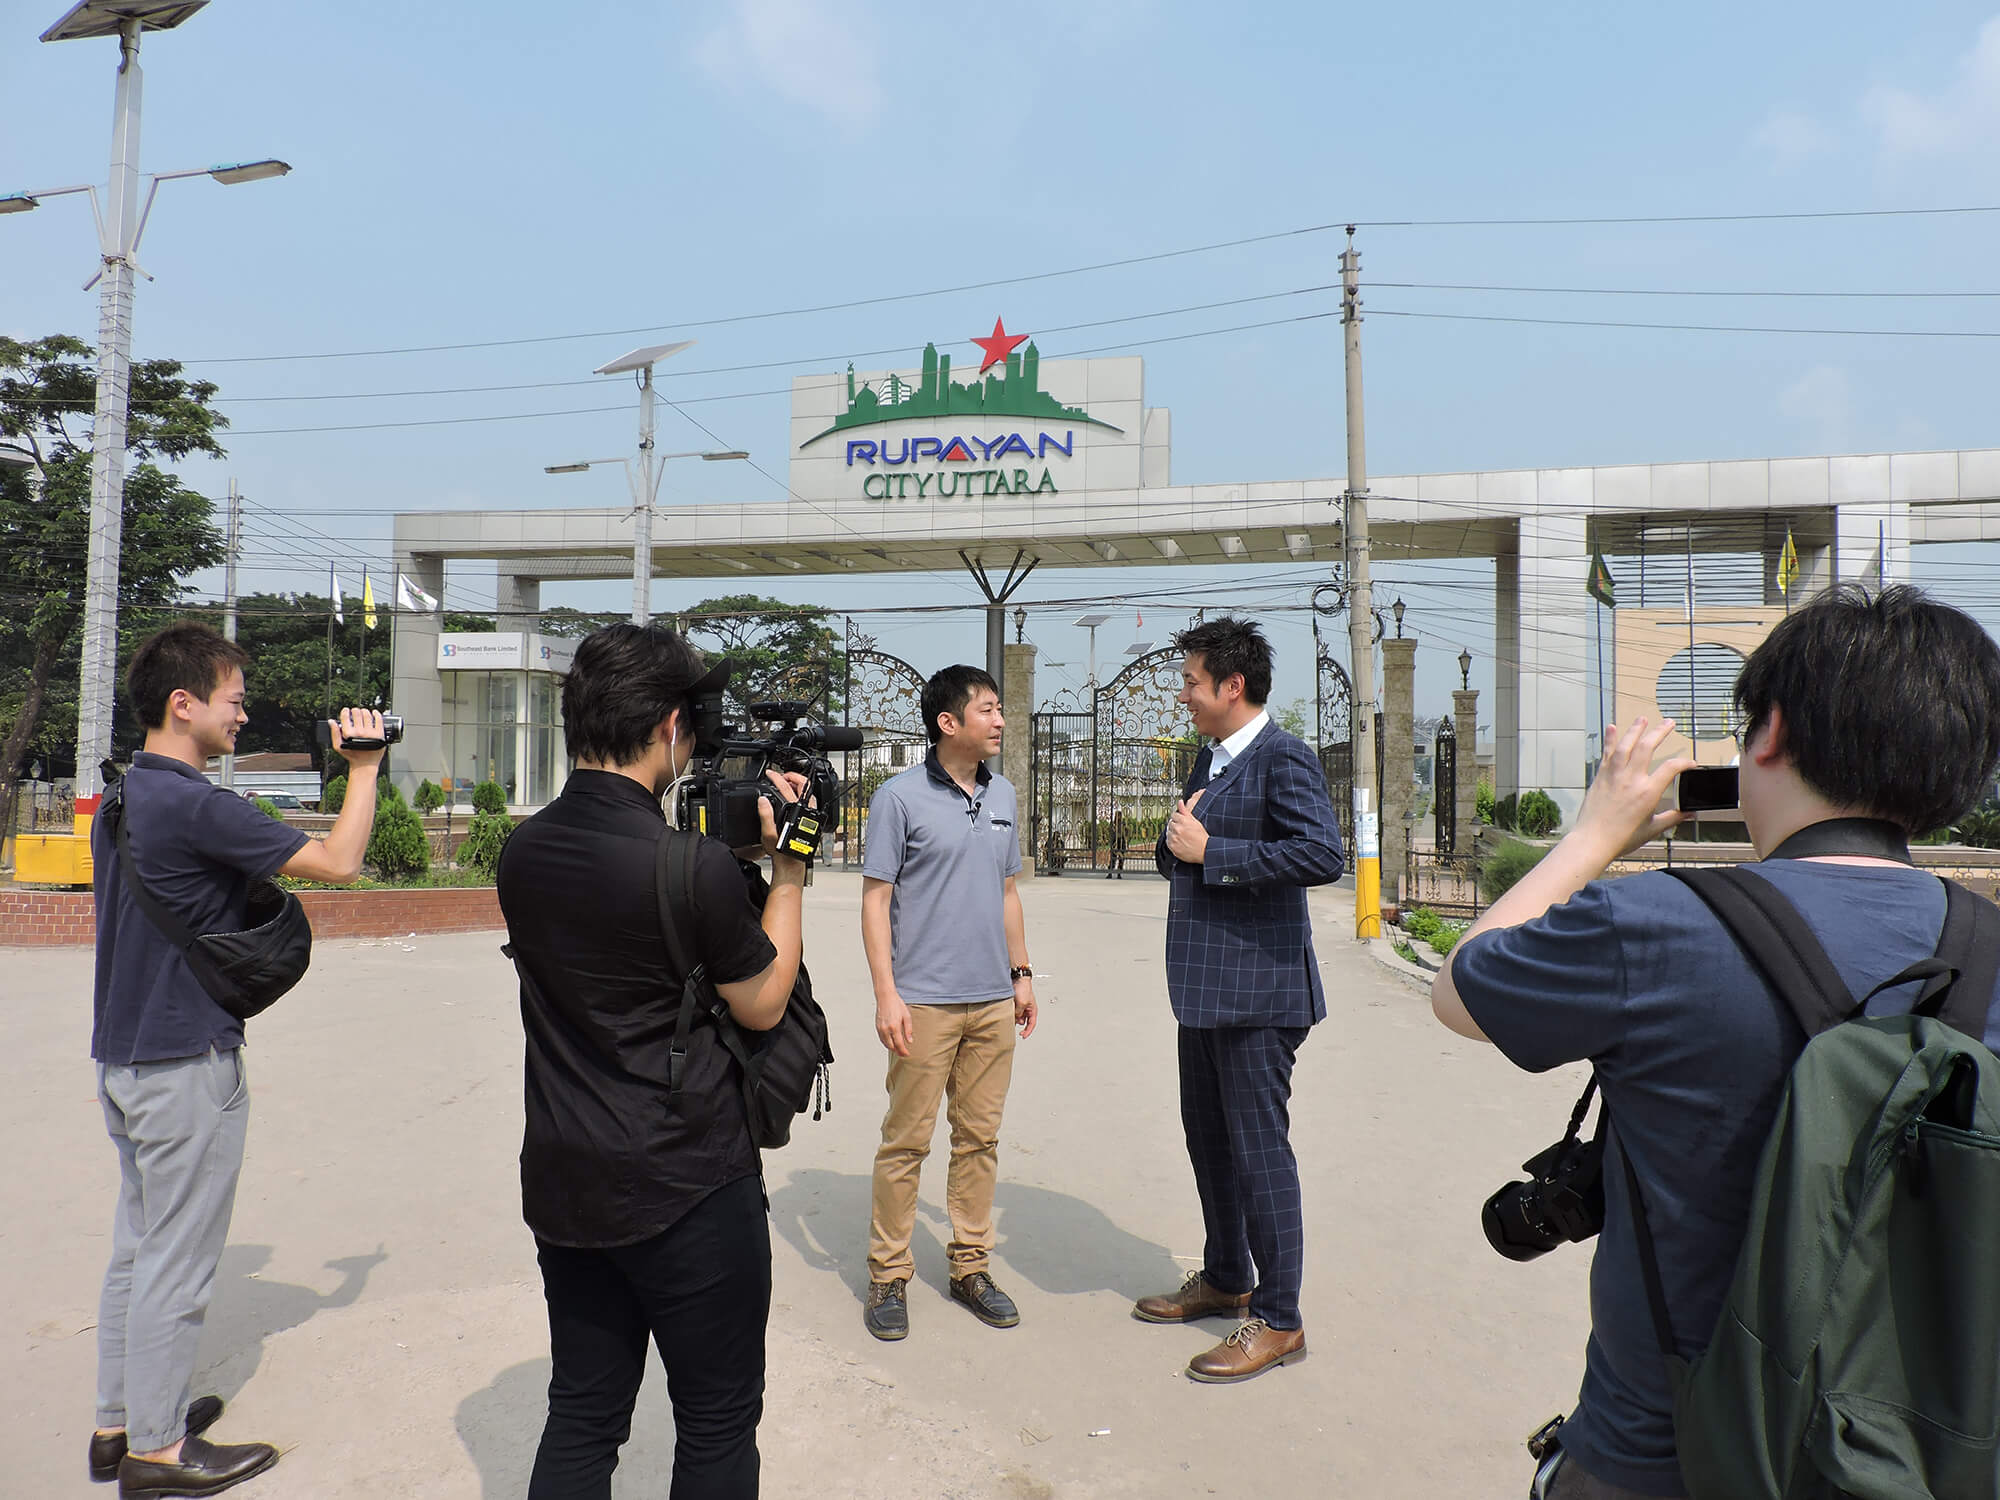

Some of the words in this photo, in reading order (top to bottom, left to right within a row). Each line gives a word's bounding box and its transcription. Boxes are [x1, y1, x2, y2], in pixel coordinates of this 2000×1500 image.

[846, 430, 1073, 466] RUPAYAN
[863, 472, 934, 499] CITY
[936, 466, 1059, 498] UTTARA
